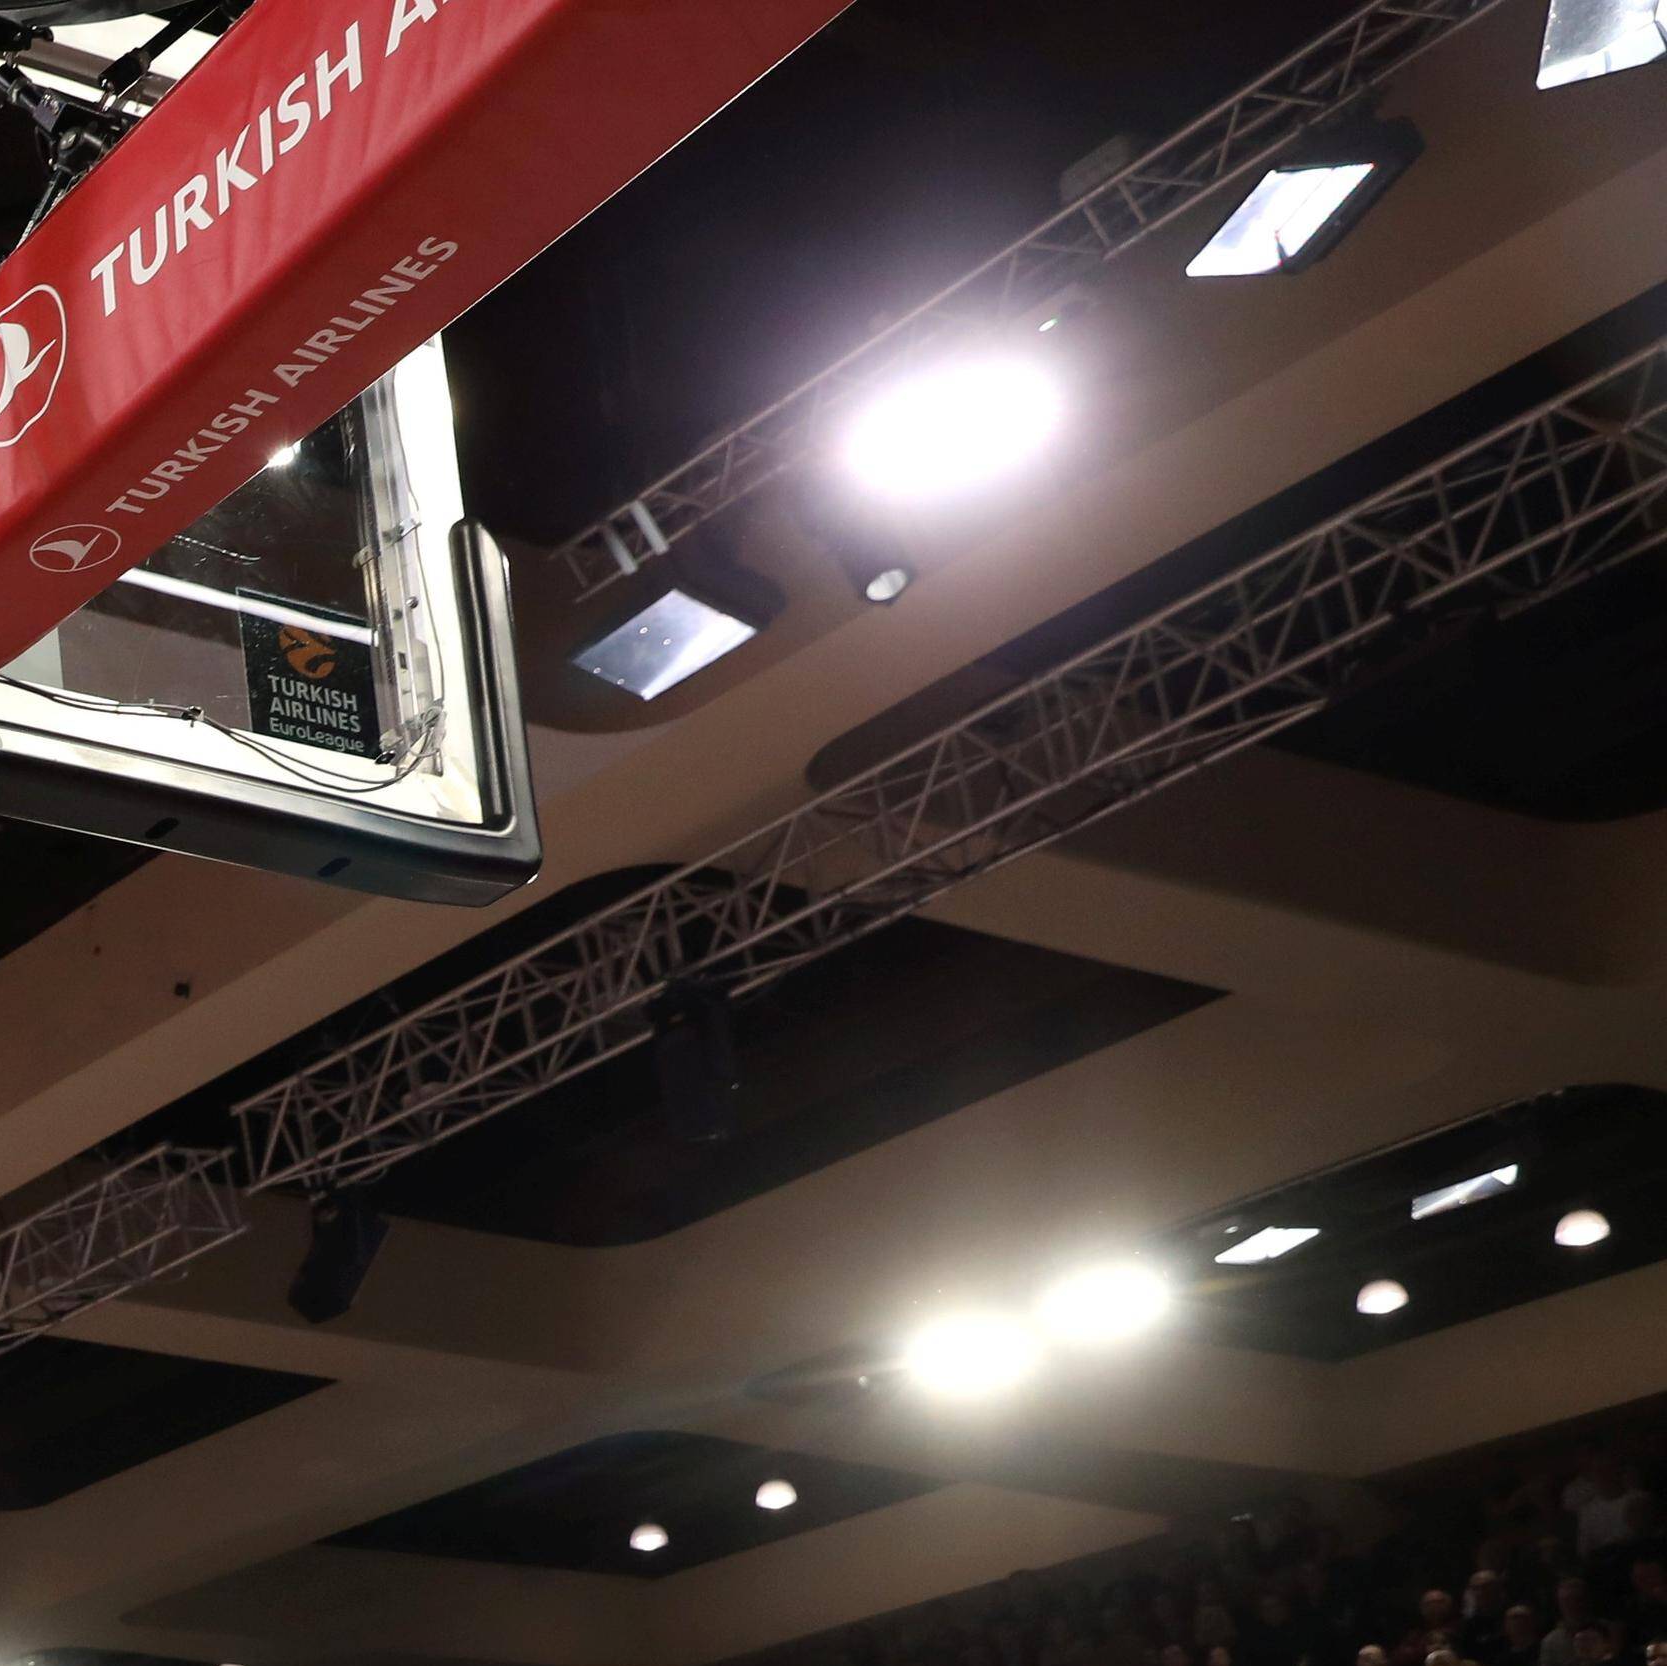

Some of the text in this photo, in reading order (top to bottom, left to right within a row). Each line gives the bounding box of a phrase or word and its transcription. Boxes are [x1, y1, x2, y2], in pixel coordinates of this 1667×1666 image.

[90, 20, 364, 318] TURKISH
[105, 236, 459, 514] TURKISH AIRLINES
[268, 674, 358, 712] TURKISH
[269, 697, 362, 733] AIRLINES
[269, 717, 365, 752] EuroLeague
